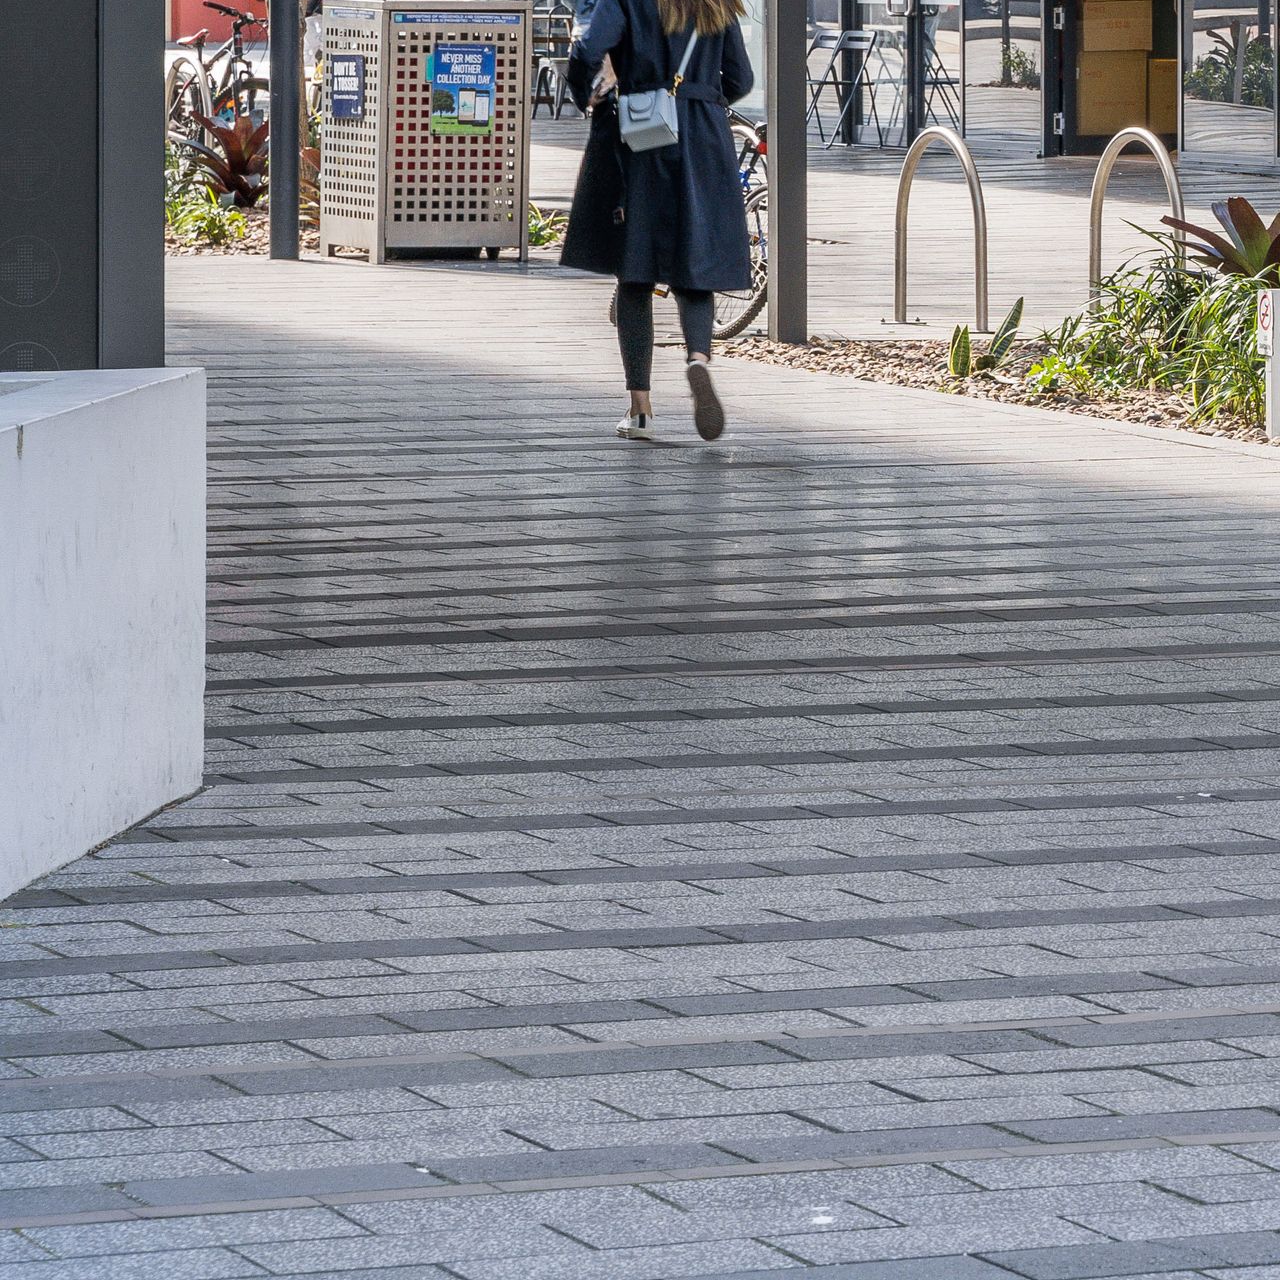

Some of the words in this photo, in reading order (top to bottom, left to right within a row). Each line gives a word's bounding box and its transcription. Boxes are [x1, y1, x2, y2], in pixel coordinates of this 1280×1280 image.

[441, 54, 463, 63] NEVER
[465, 55, 482, 63] MISS
[450, 64, 481, 73] ANOTHER
[437, 74, 476, 83] COLLECTION
[477, 75, 491, 84] DAY
